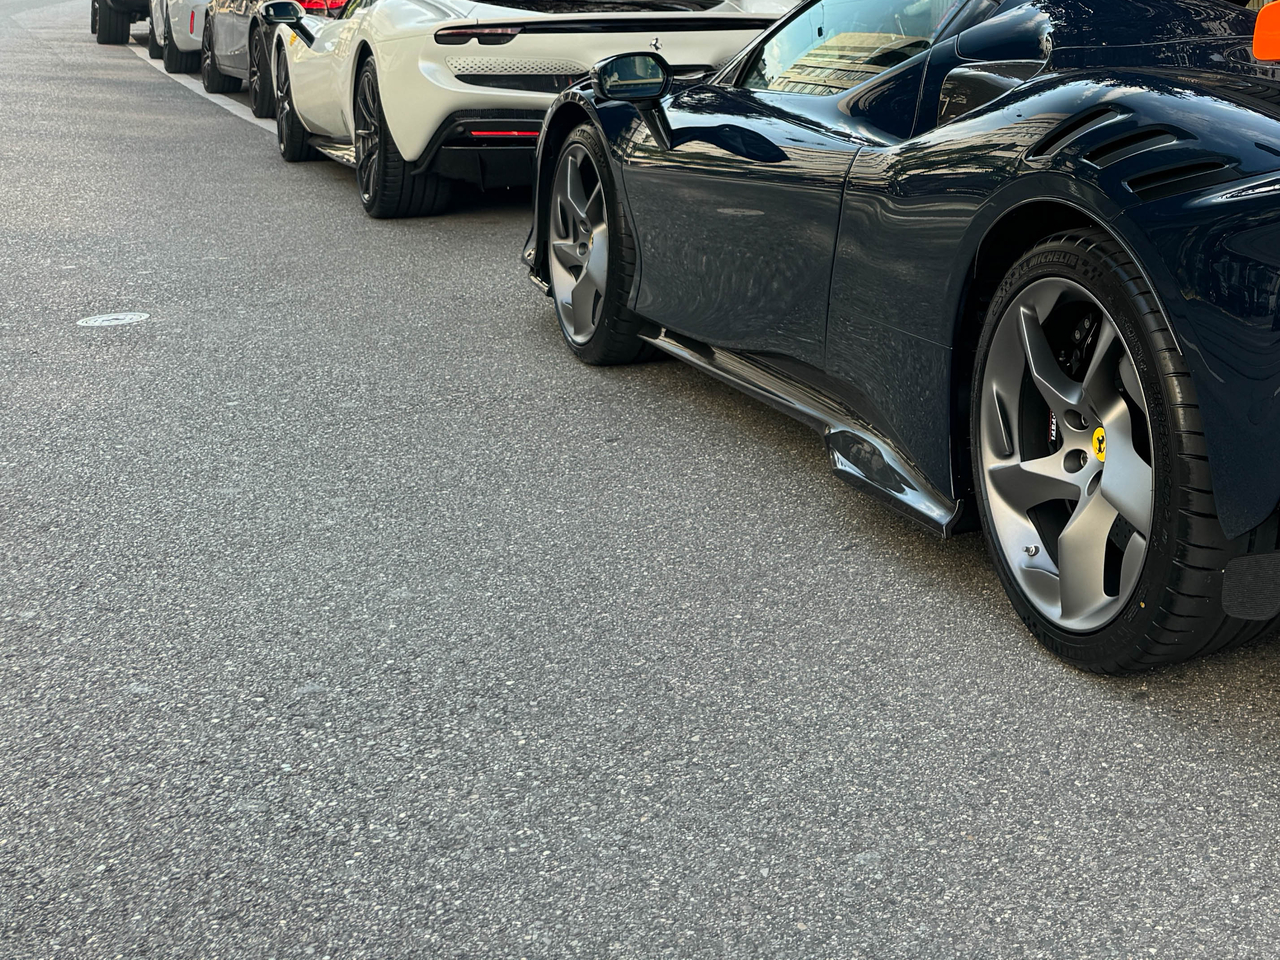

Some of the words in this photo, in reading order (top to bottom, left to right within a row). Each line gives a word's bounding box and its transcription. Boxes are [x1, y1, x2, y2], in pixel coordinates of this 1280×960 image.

[1029, 251, 1079, 268] MICHELIN
[1150, 381, 1167, 422] Pilot
[1157, 422, 1173, 474] Sport
[1162, 474, 1173, 509] Cup
